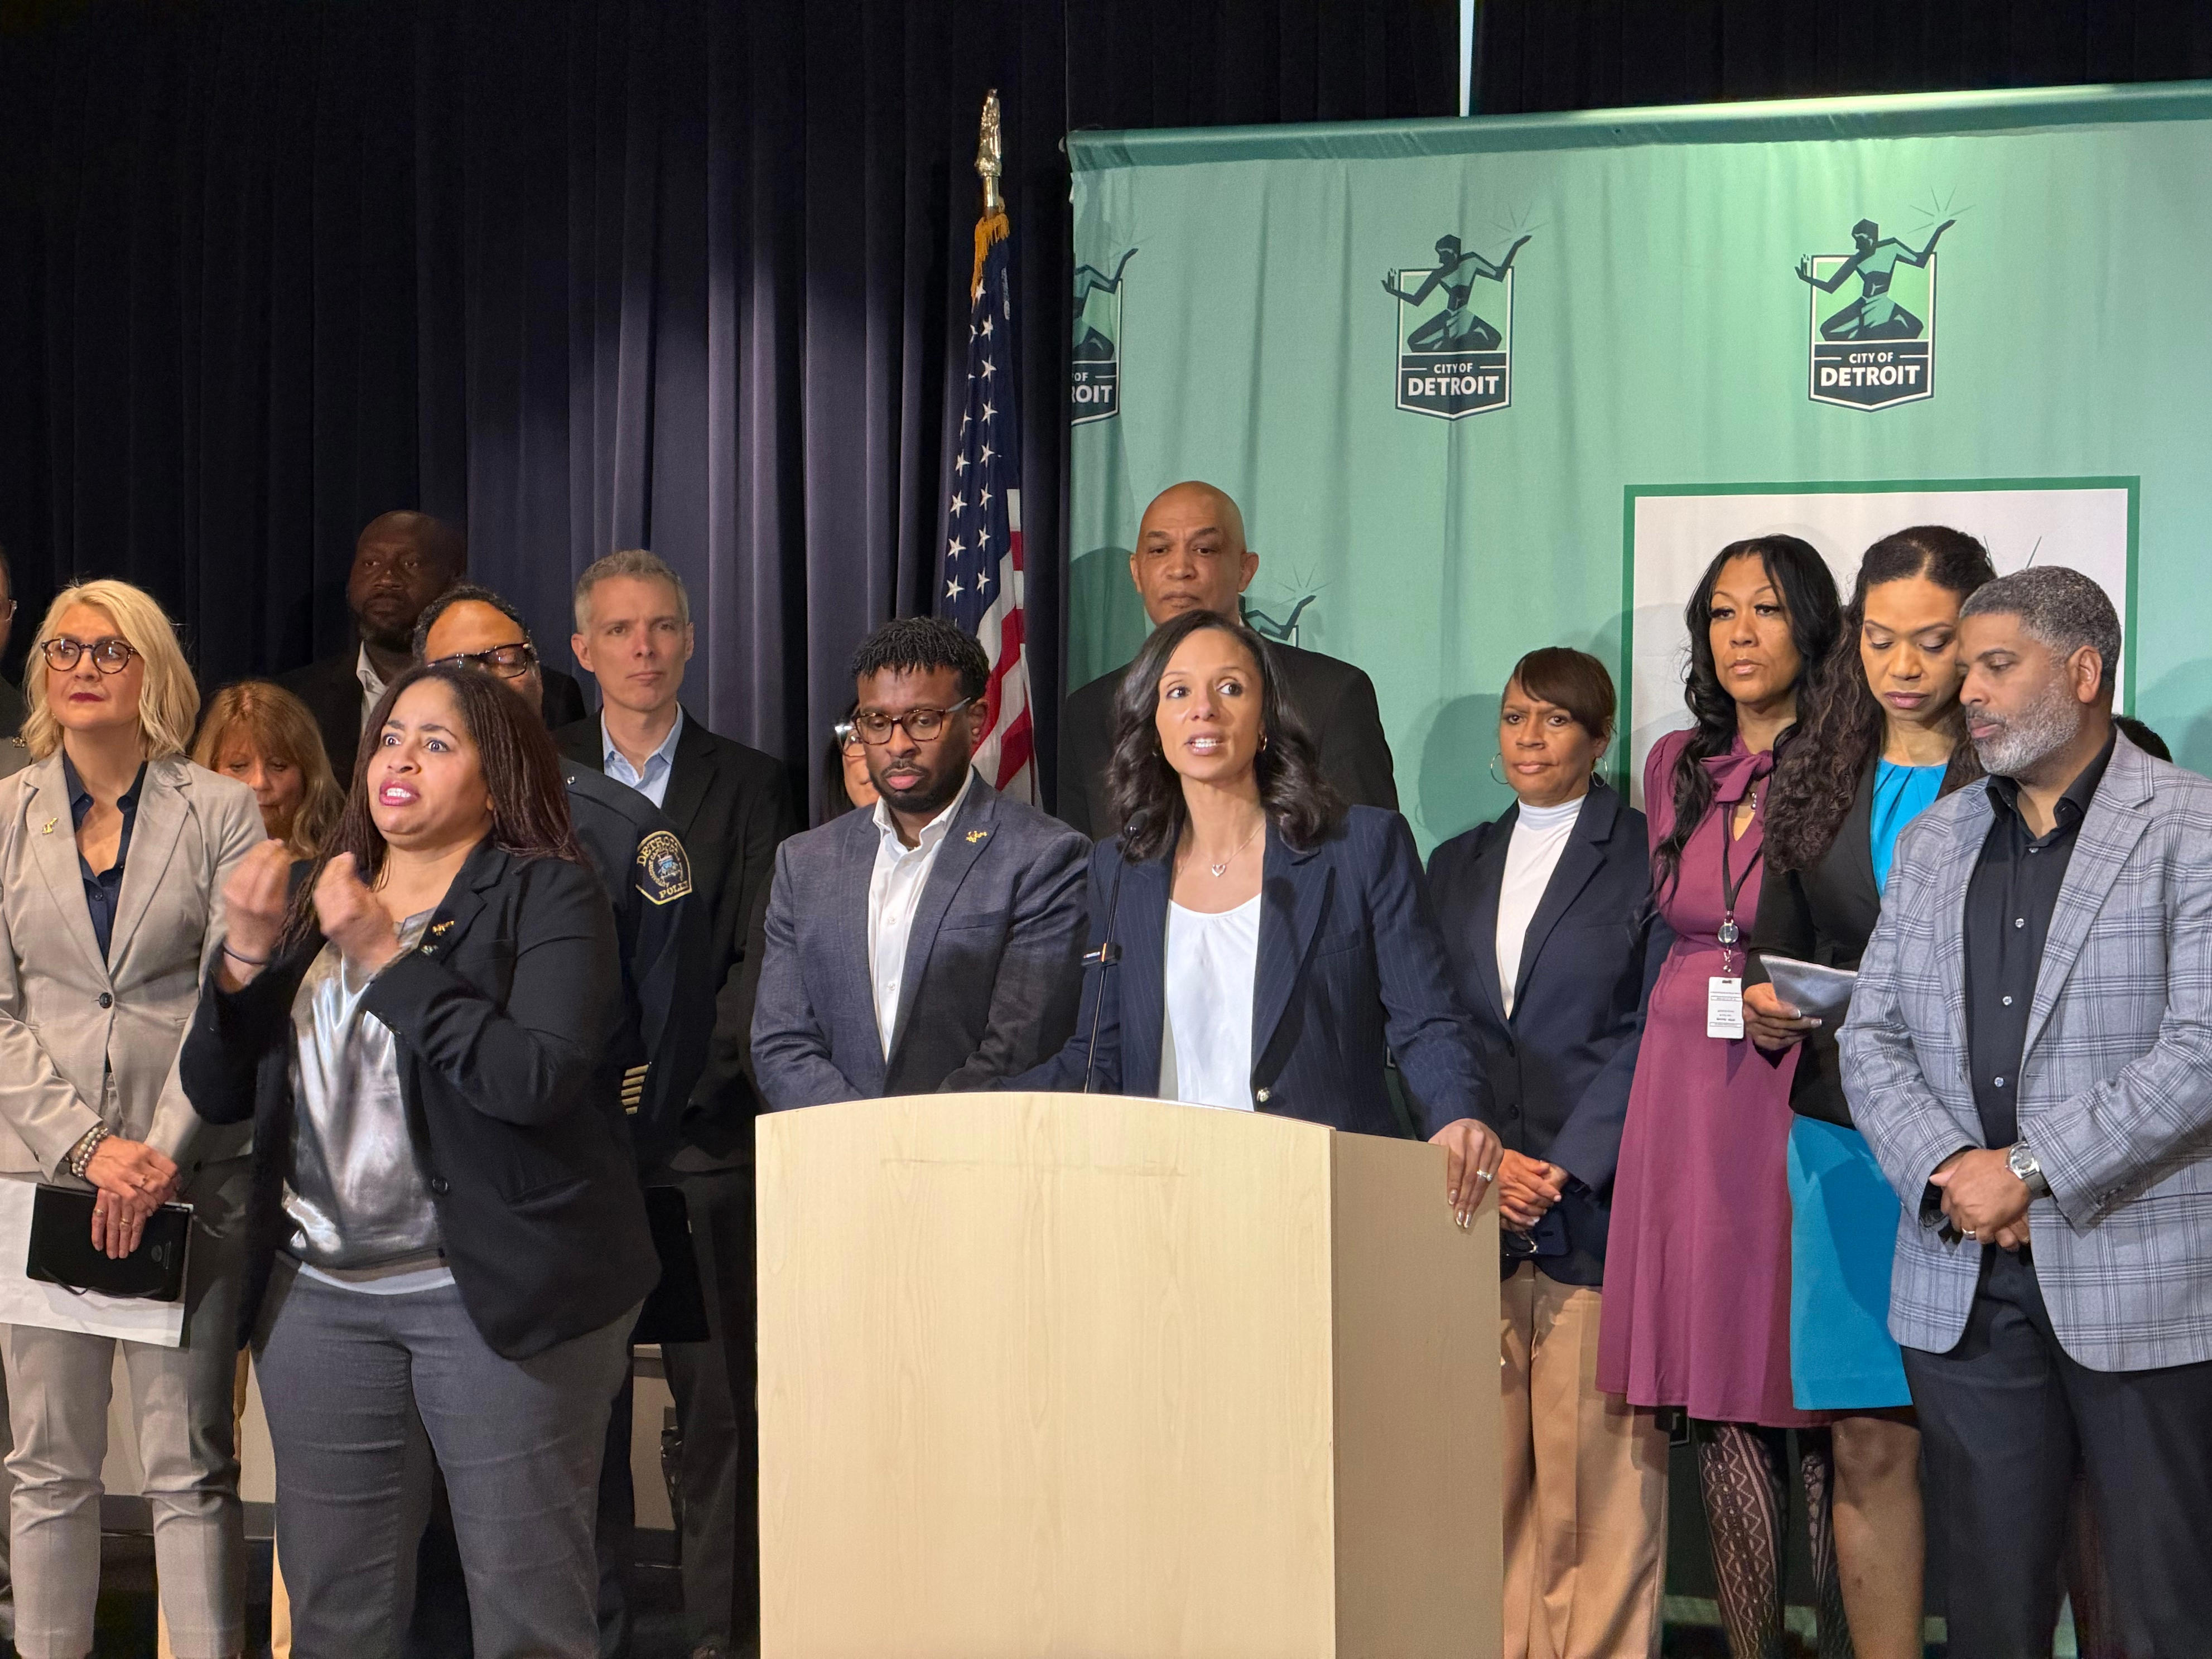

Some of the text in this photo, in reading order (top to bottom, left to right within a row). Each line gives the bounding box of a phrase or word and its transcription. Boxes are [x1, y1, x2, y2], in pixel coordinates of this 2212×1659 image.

[1849, 352, 1893, 363] CITY OF
[1433, 363, 1473, 374] CITY OF
[1074, 372, 1089, 382] OF
[1820, 365, 1920, 387] DETROIT
[1408, 375, 1500, 396] DETROIT
